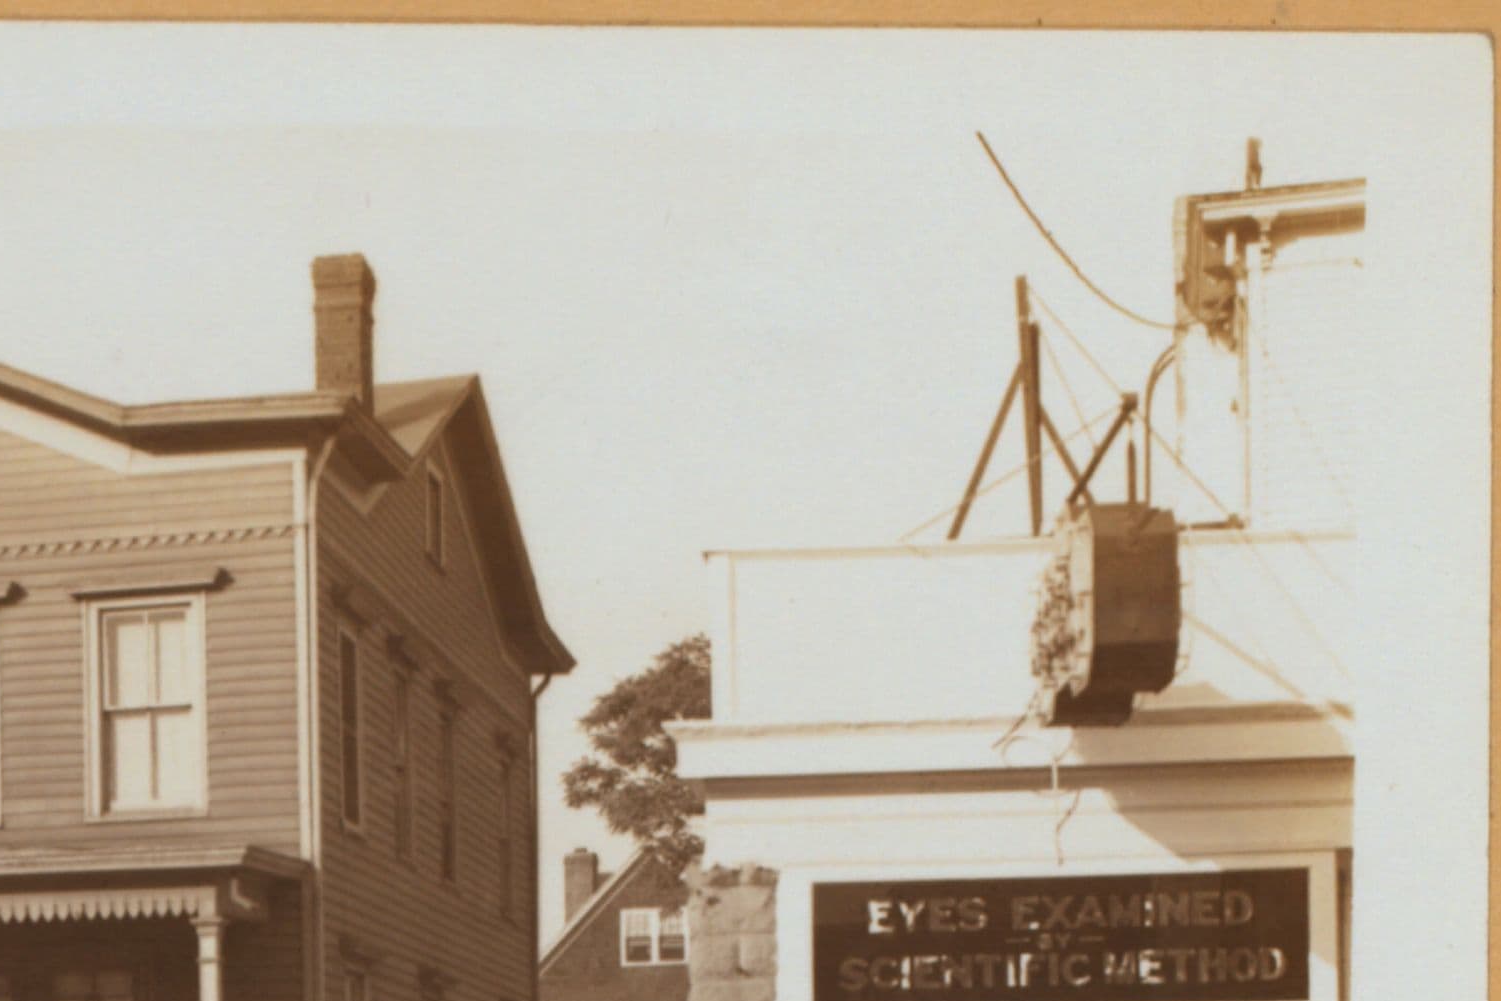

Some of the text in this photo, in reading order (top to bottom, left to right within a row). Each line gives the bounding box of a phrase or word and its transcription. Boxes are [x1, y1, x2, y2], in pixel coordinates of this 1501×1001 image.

[867, 891, 1254, 933] EYES EXAMINED
[1037, 932, 1072, 951] BY
[839, 947, 1287, 991] SCIENTIFIC METHOD
